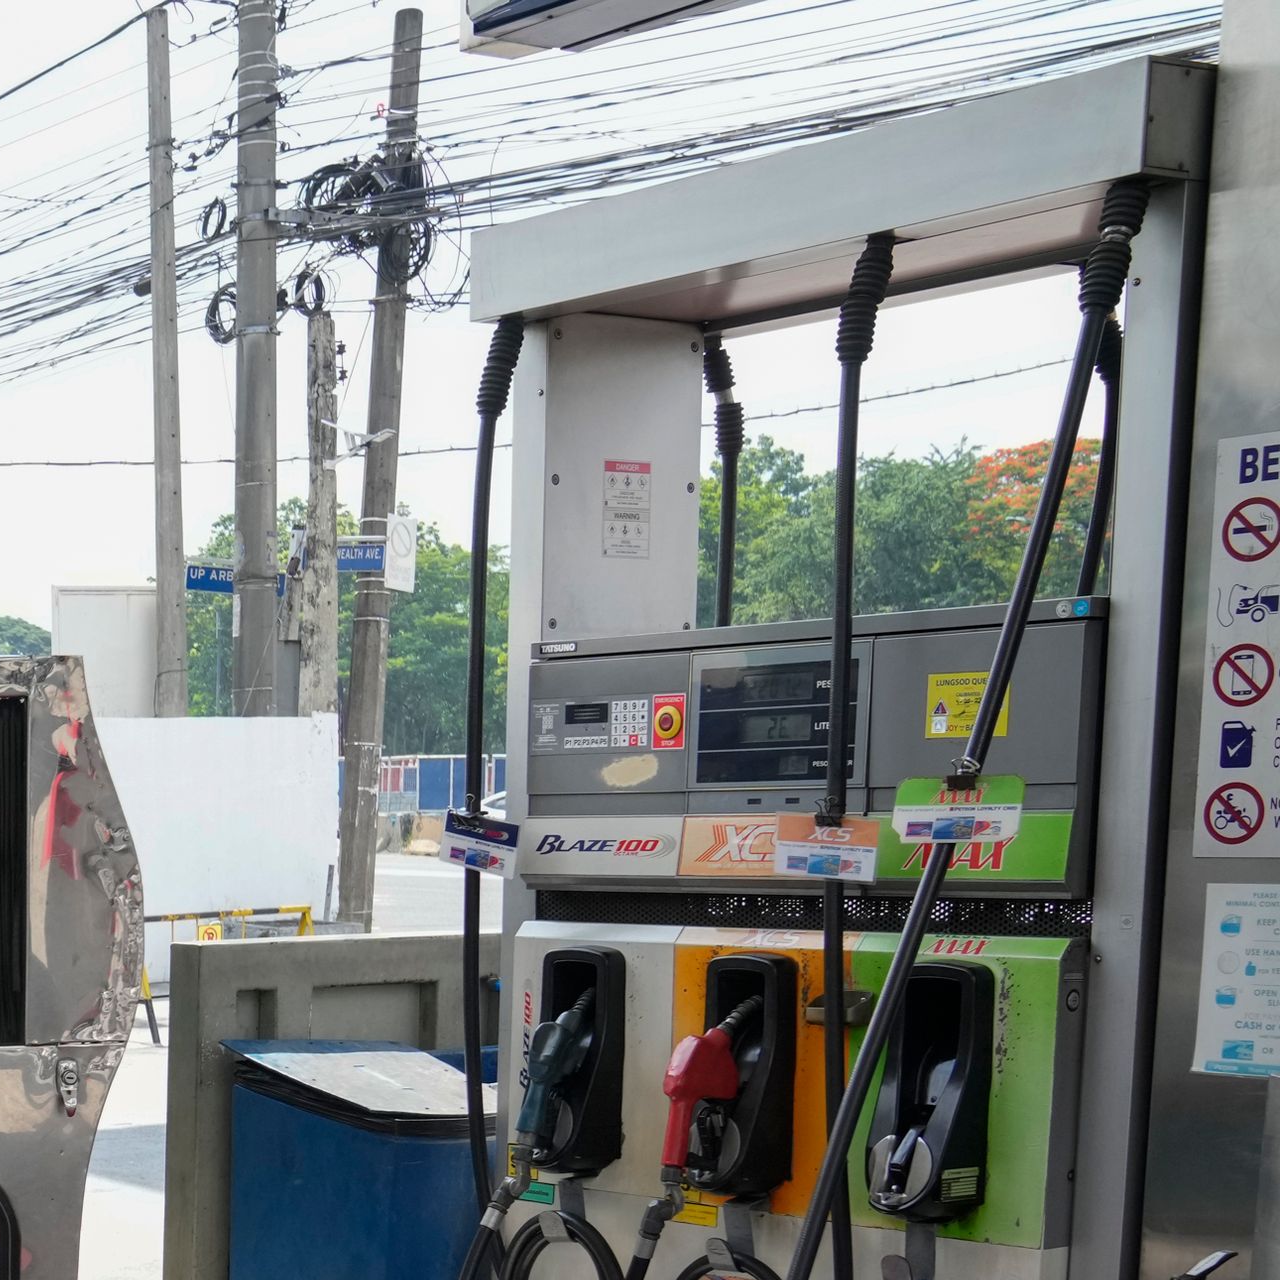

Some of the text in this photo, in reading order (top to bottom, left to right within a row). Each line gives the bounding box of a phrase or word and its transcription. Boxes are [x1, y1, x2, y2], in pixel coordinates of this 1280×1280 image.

[614, 513, 640, 521] WARNING
[190, 568, 206, 580] UP
[541, 643, 575, 653] TATSUNO
[936, 678, 970, 687] LUNGSOD
[565, 737, 607, 746] P1 P2 P3 P4 P5
[661, 739, 675, 747] STOP
[809, 826, 854, 842] XCS
[536, 835, 661, 855] BLAZE 100
[697, 824, 776, 862] XC
[1257, 918, 1278, 926] KEEP
[1245, 948, 1260, 957] USE
[1254, 989, 1278, 997] OPEN
[1235, 1020, 1263, 1030] CASH
[1262, 1047, 1274, 1055] OR
